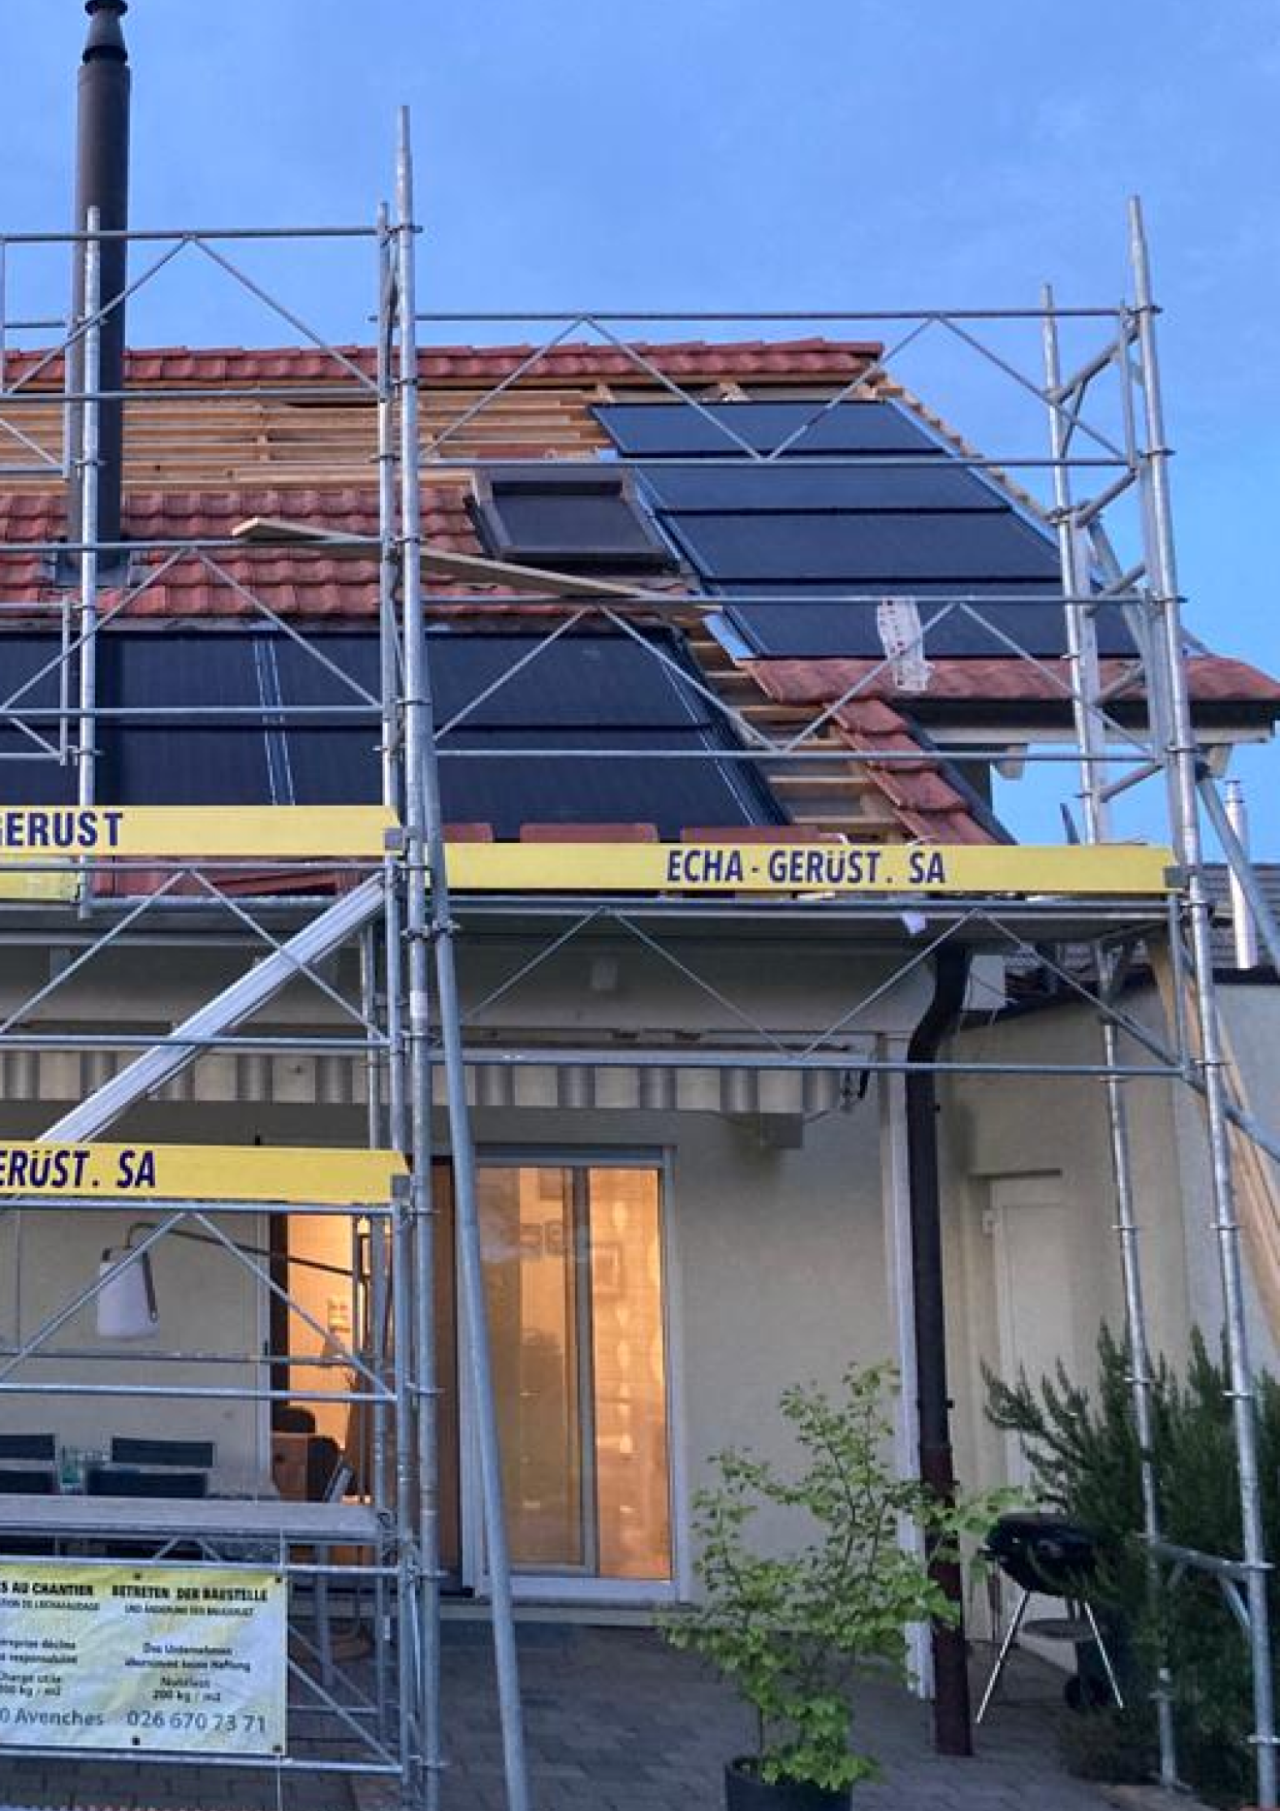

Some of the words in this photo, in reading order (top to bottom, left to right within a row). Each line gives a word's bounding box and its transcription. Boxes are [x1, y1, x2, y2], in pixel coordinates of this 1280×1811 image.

[667, 849, 743, 883] ECHA
[908, 851, 946, 884] SA
[116, 1149, 156, 1188] SA
[15, 1707, 104, 1726] Avenches
[127, 1710, 166, 1729] 026
[170, 1712, 208, 1730] 670
[213, 1713, 237, 1732] 73
[242, 1714, 266, 1734] 71
